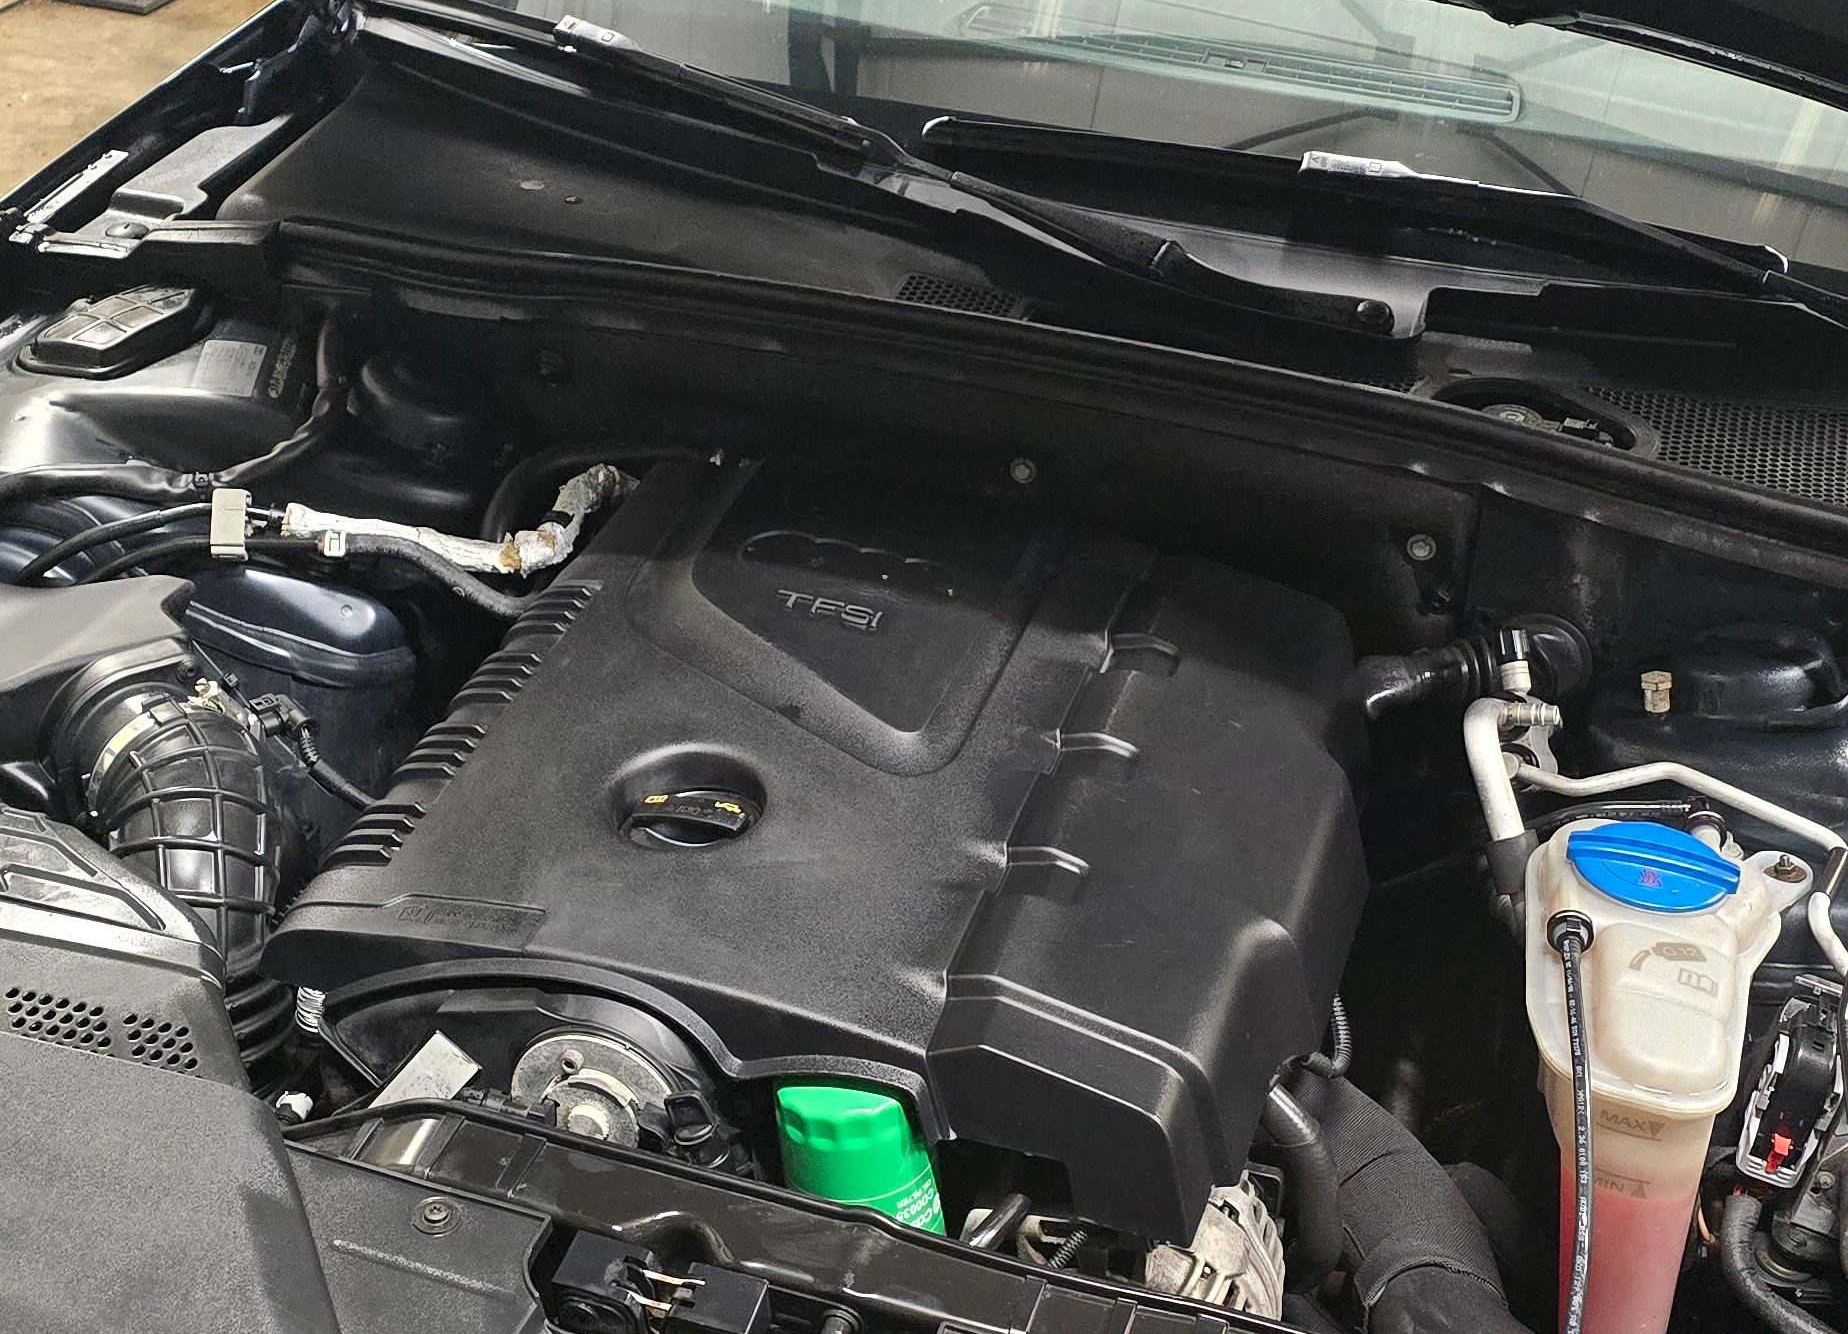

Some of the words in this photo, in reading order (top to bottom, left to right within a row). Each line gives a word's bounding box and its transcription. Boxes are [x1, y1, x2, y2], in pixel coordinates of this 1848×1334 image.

[777, 589, 883, 632] TFSI
[1661, 945, 1699, 958] G12
[1600, 1110, 1647, 1132] MAX
